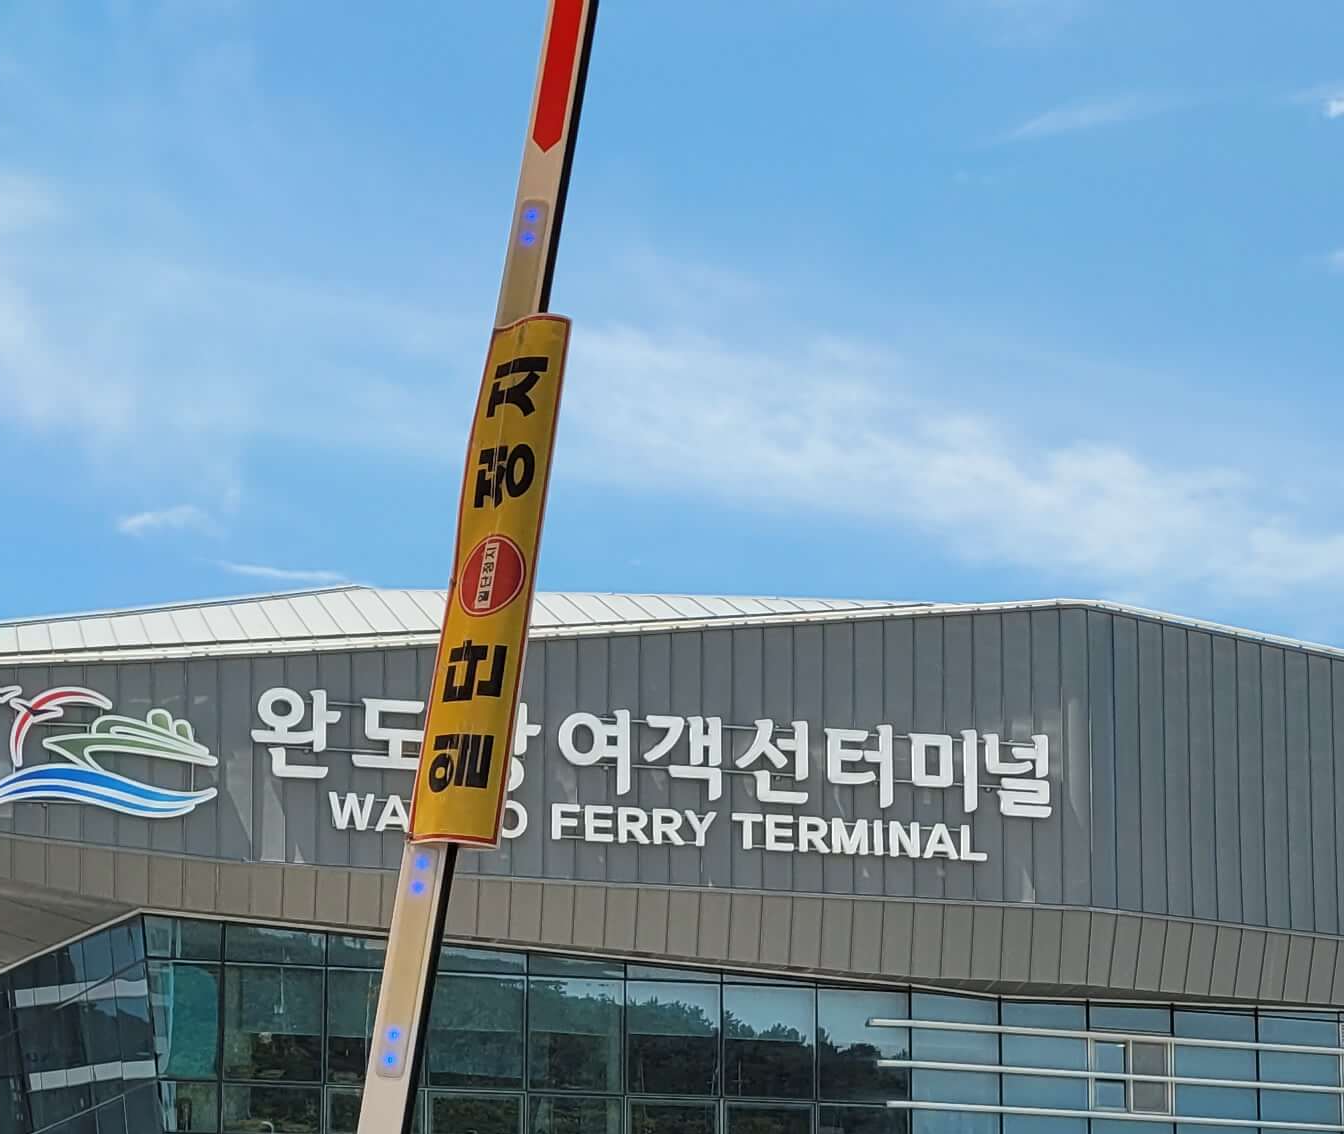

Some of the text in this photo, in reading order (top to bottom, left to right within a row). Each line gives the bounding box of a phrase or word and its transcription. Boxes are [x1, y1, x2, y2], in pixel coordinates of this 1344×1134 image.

[478, 547, 497, 602] 일단정지
[328, 791, 988, 861] WAO FERRY TERMINAL
